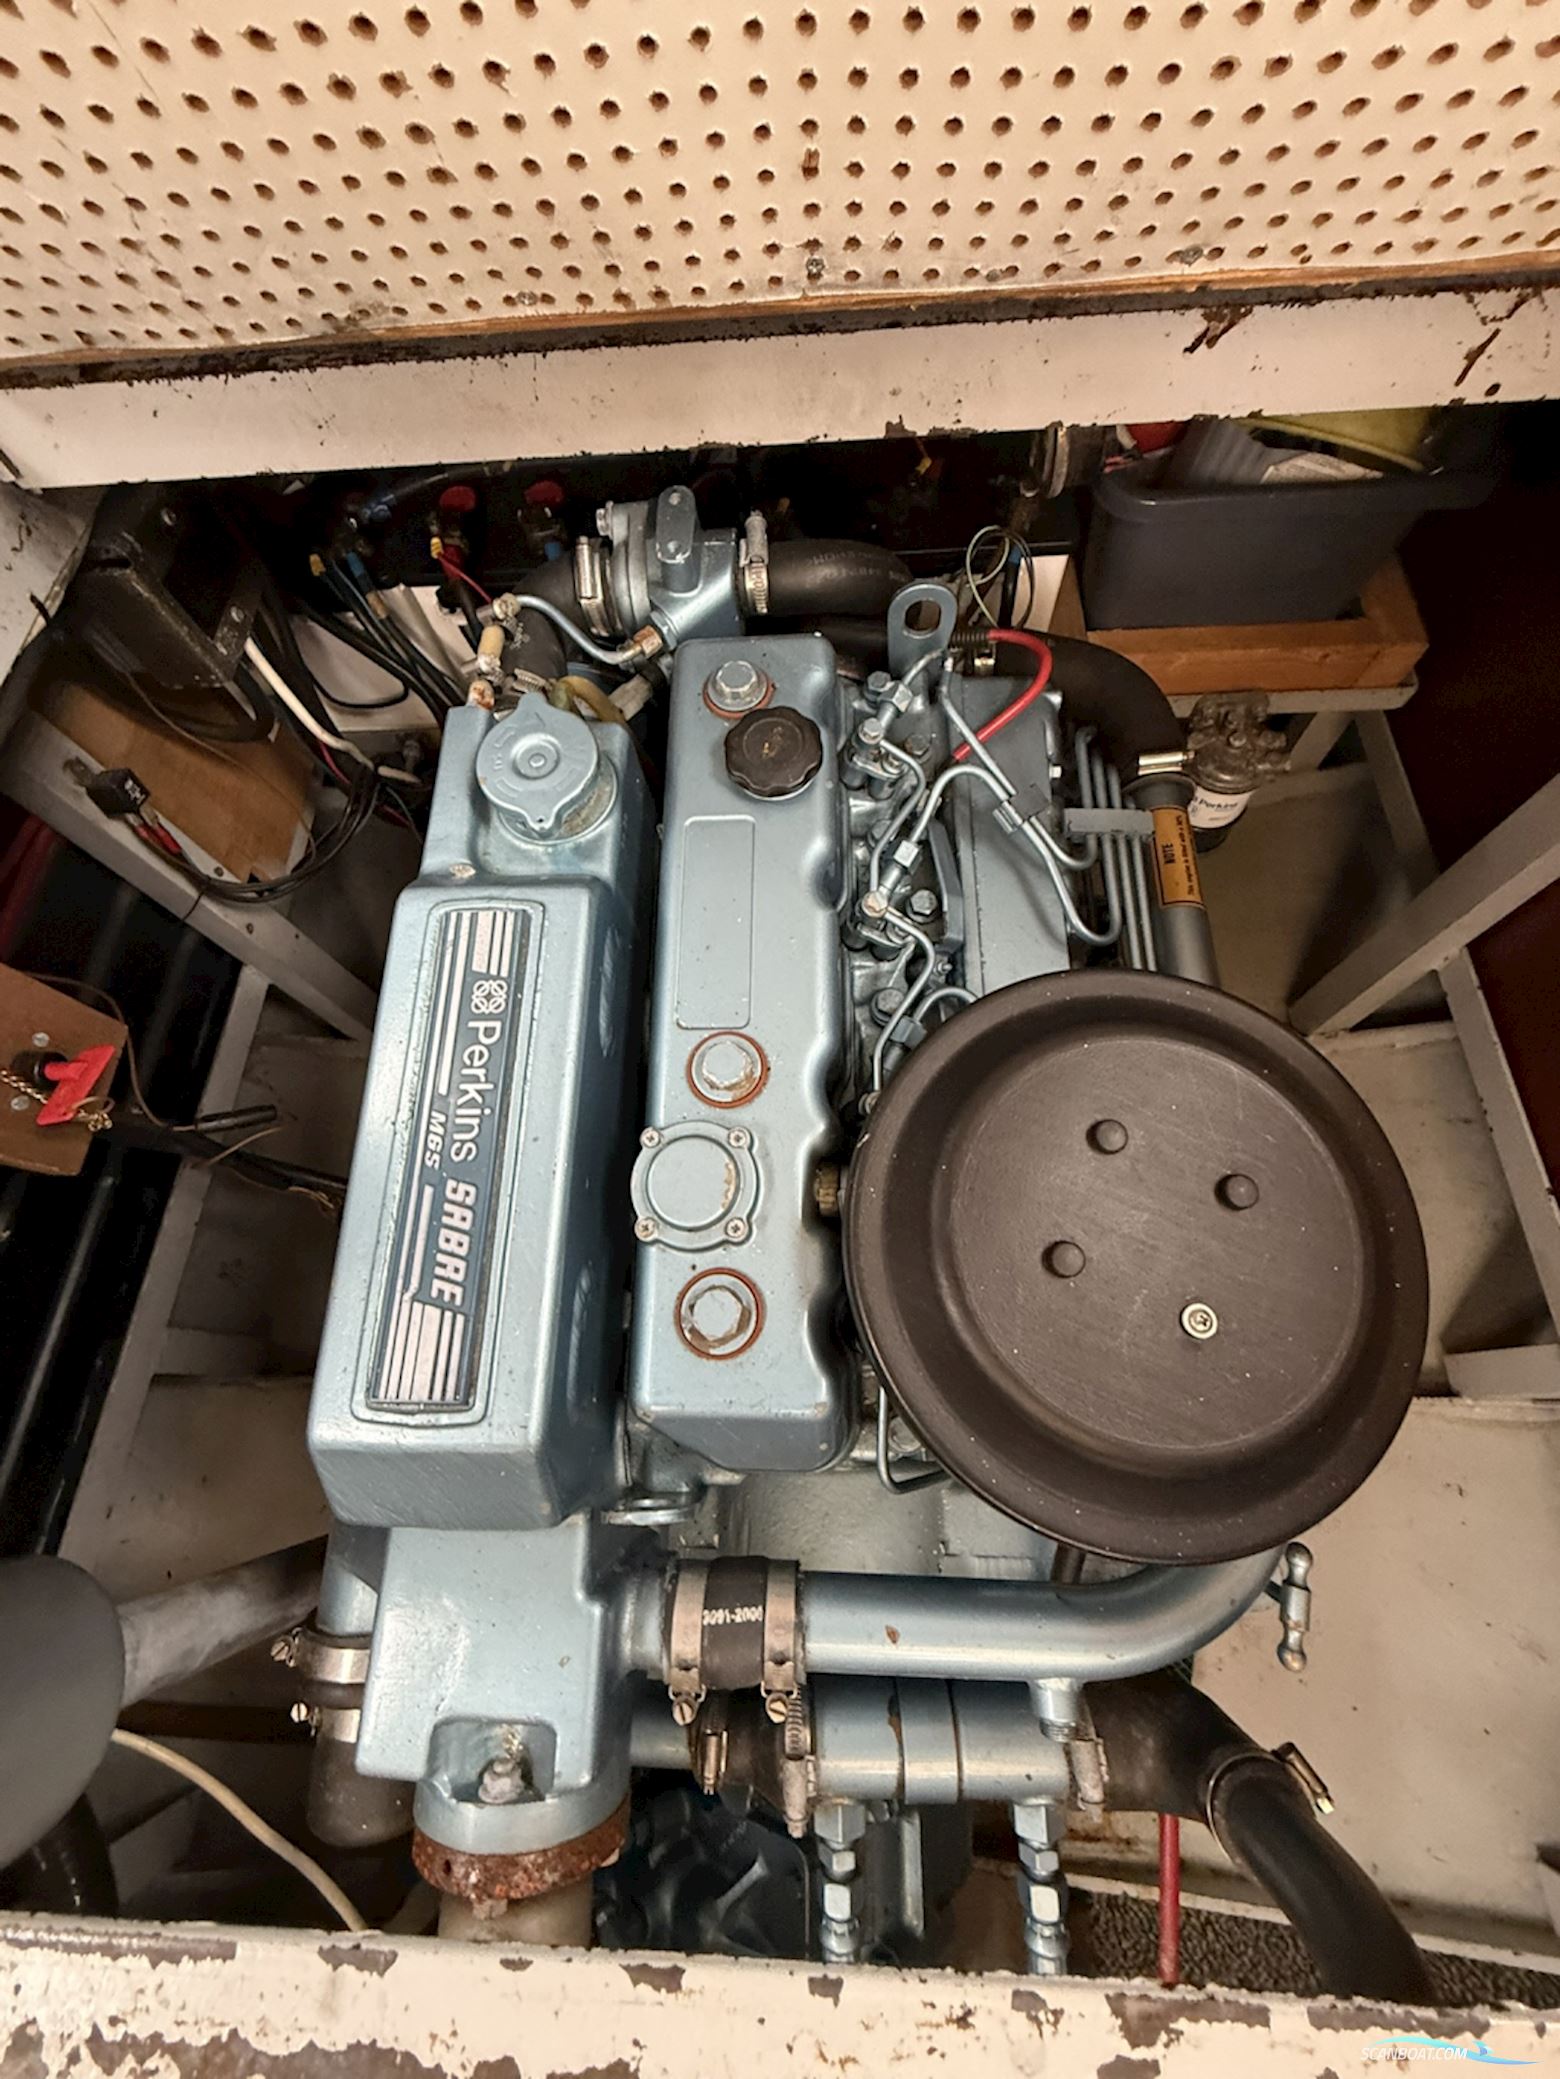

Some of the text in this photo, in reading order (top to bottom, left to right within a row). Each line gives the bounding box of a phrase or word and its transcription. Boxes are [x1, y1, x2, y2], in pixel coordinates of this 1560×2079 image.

[1162, 842, 1176, 864] NOTE
[424, 1109, 447, 1170] M65
[430, 1020, 502, 1307] Perkins SABRE
